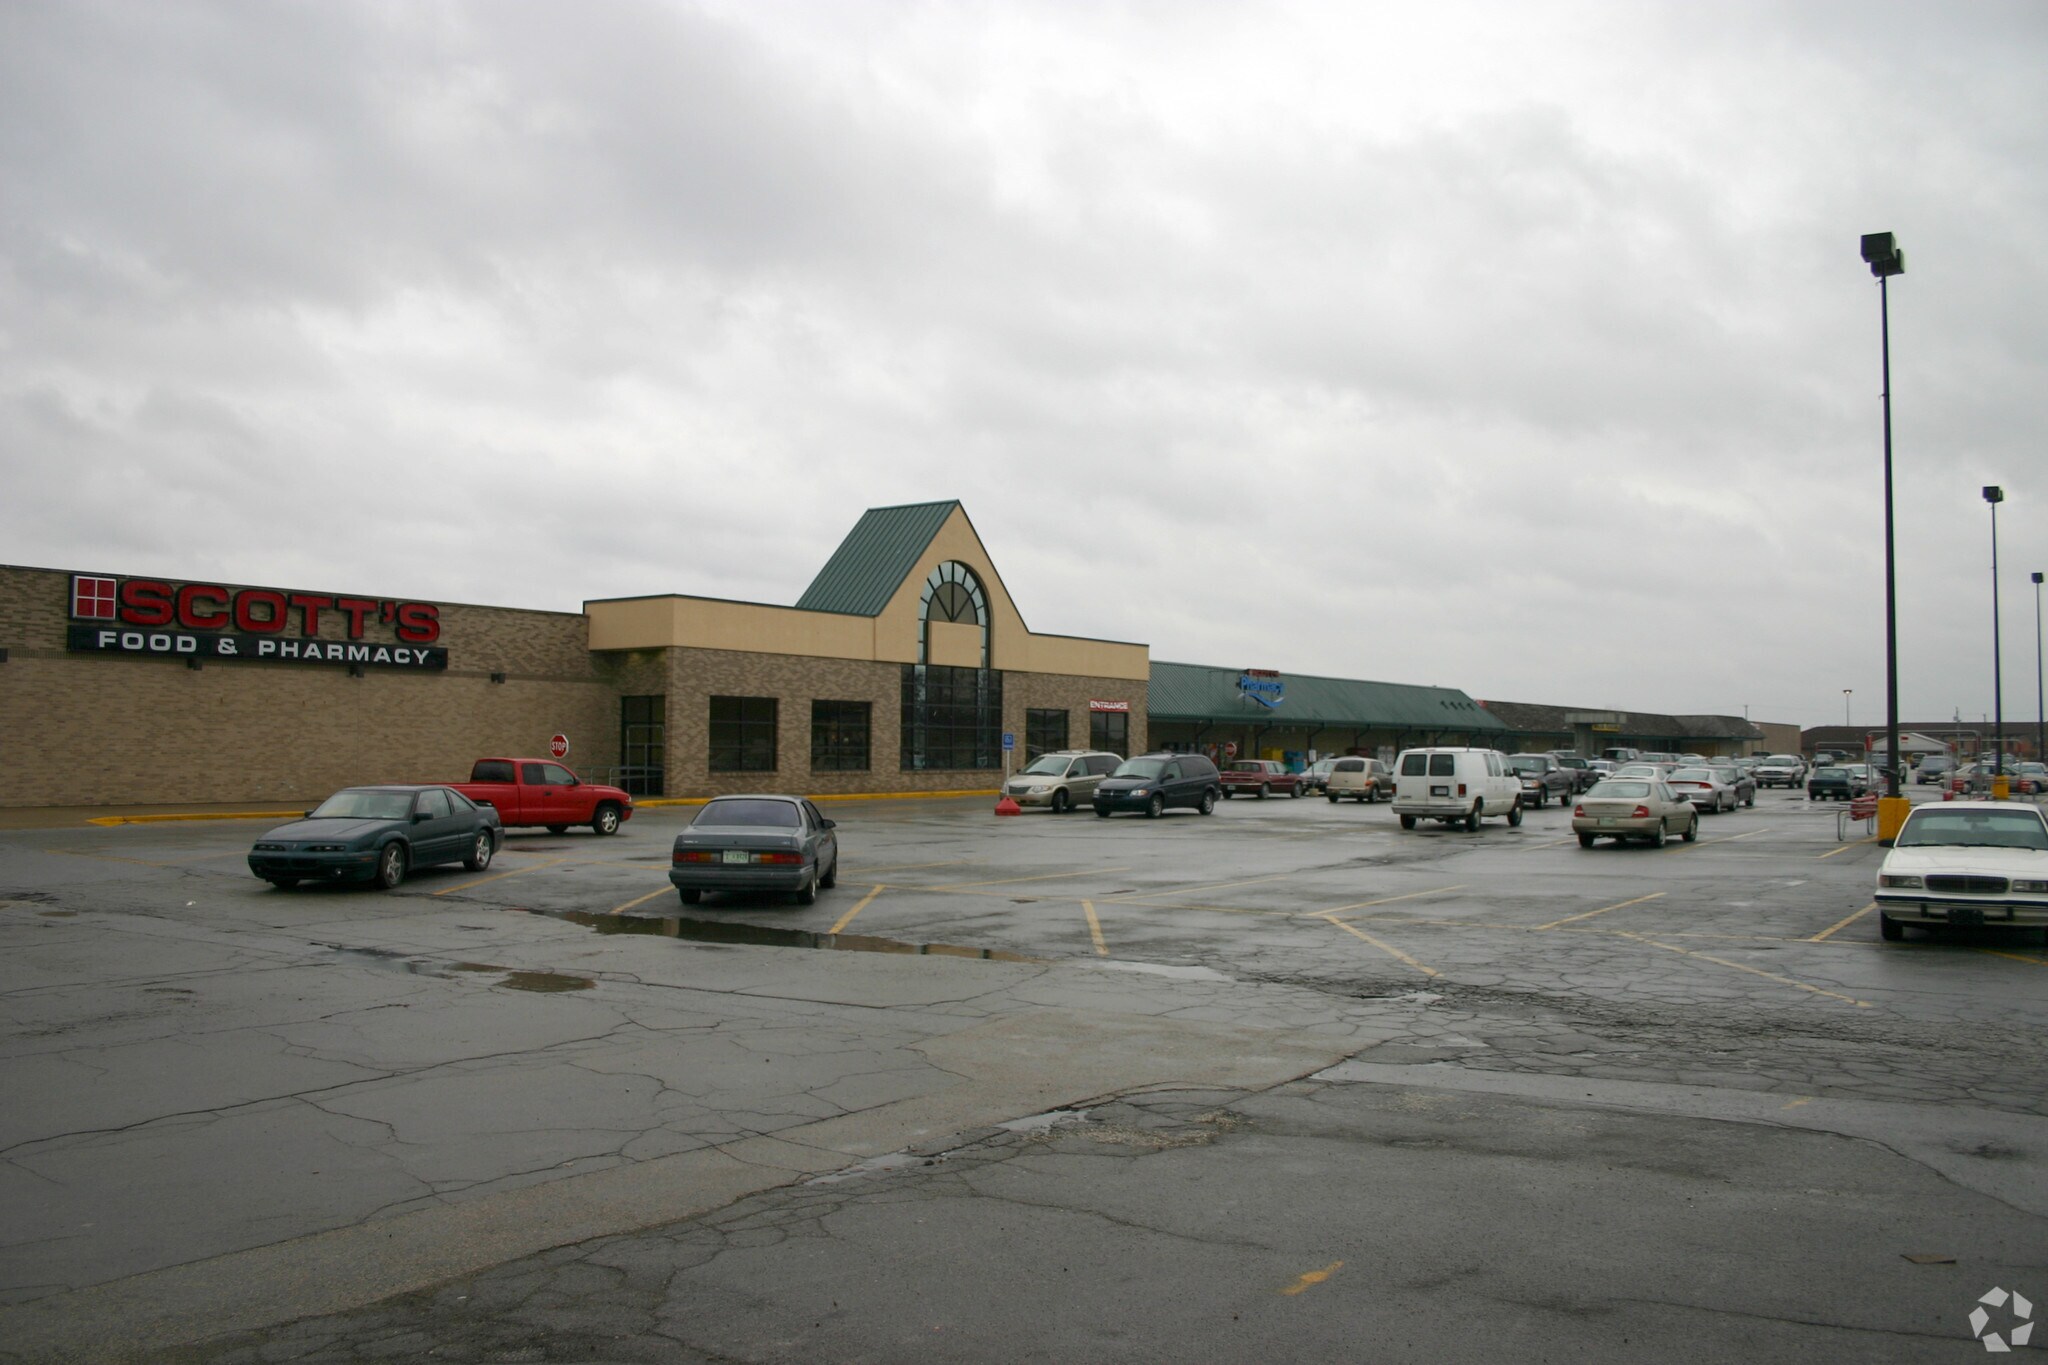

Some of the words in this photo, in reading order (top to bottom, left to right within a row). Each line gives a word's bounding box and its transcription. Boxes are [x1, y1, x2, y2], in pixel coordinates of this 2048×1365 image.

[121, 580, 440, 643] SCOTT'S
[98, 631, 197, 653] FOOD
[217, 637, 238, 655] &
[258, 640, 429, 665] PHARMACY
[1241, 675, 1286, 696] Pharmacy
[1089, 700, 1129, 710] ENTRANCE
[551, 741, 567, 752] STOP
